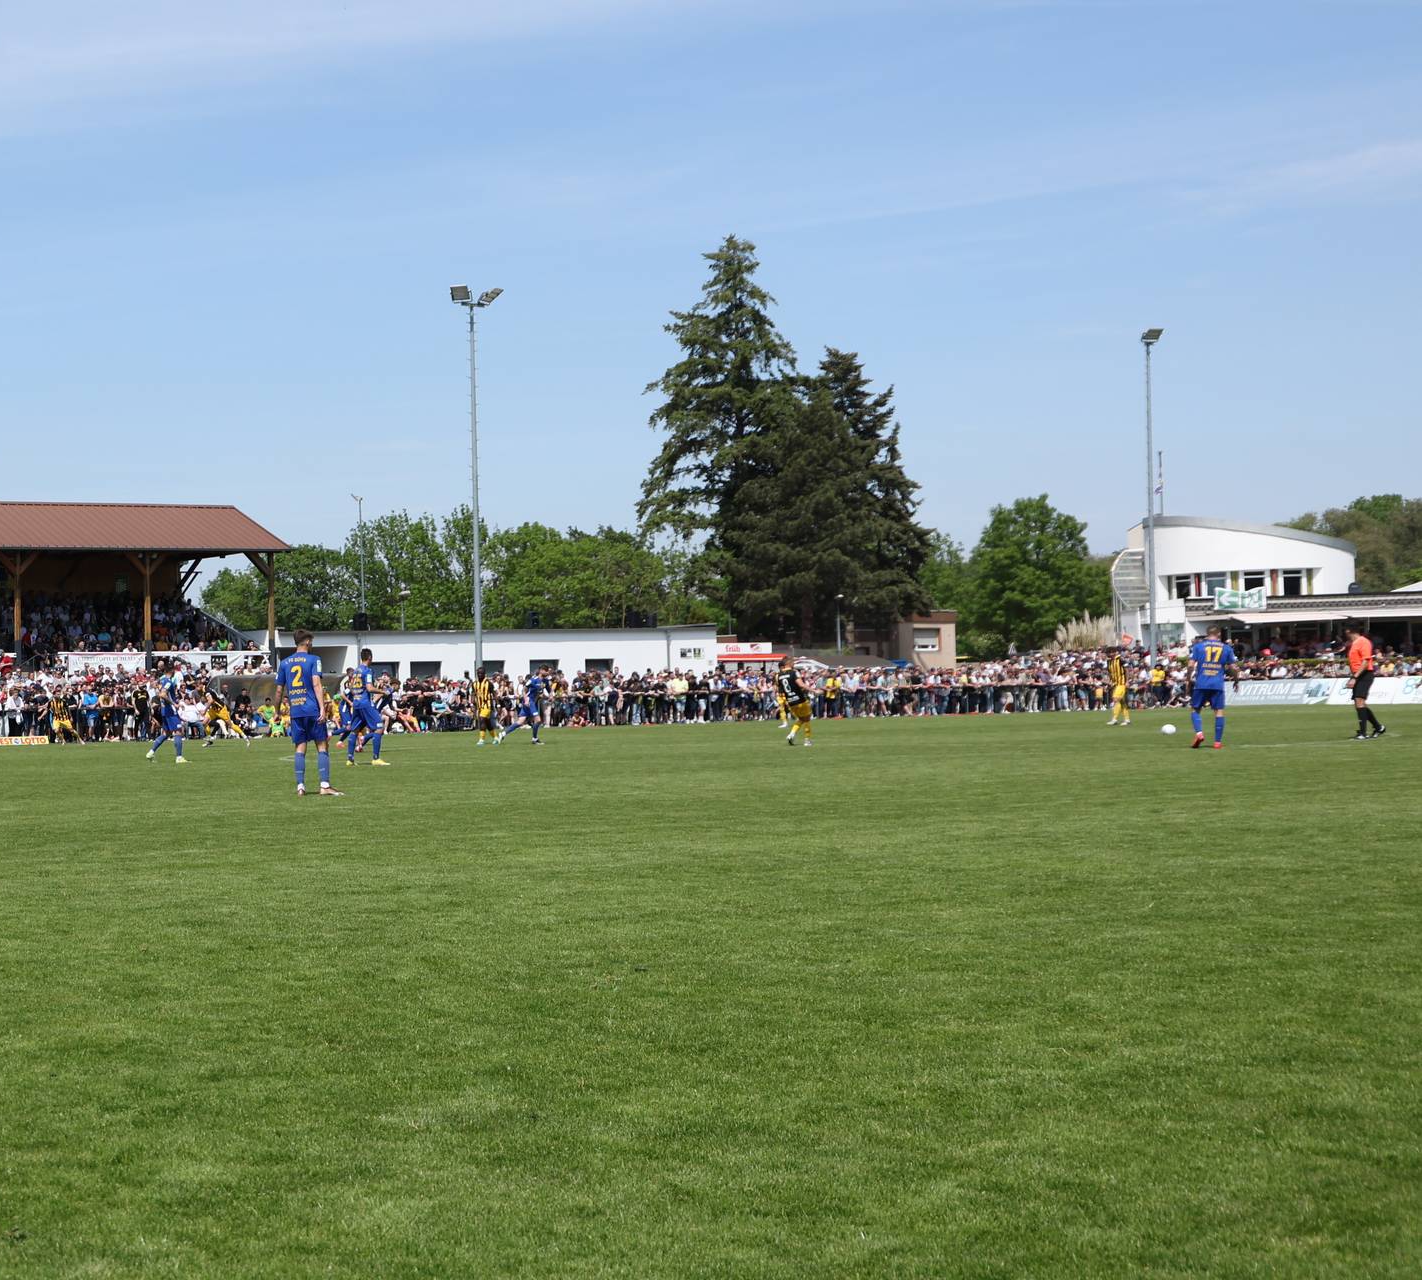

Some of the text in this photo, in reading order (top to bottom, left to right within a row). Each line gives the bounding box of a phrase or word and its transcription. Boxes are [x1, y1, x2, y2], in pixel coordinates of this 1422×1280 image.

[1204, 646, 1223, 662] 17
[290, 665, 303, 687] 2
[782, 678, 792, 693] 8
[1239, 683, 1291, 695] VITRUM
